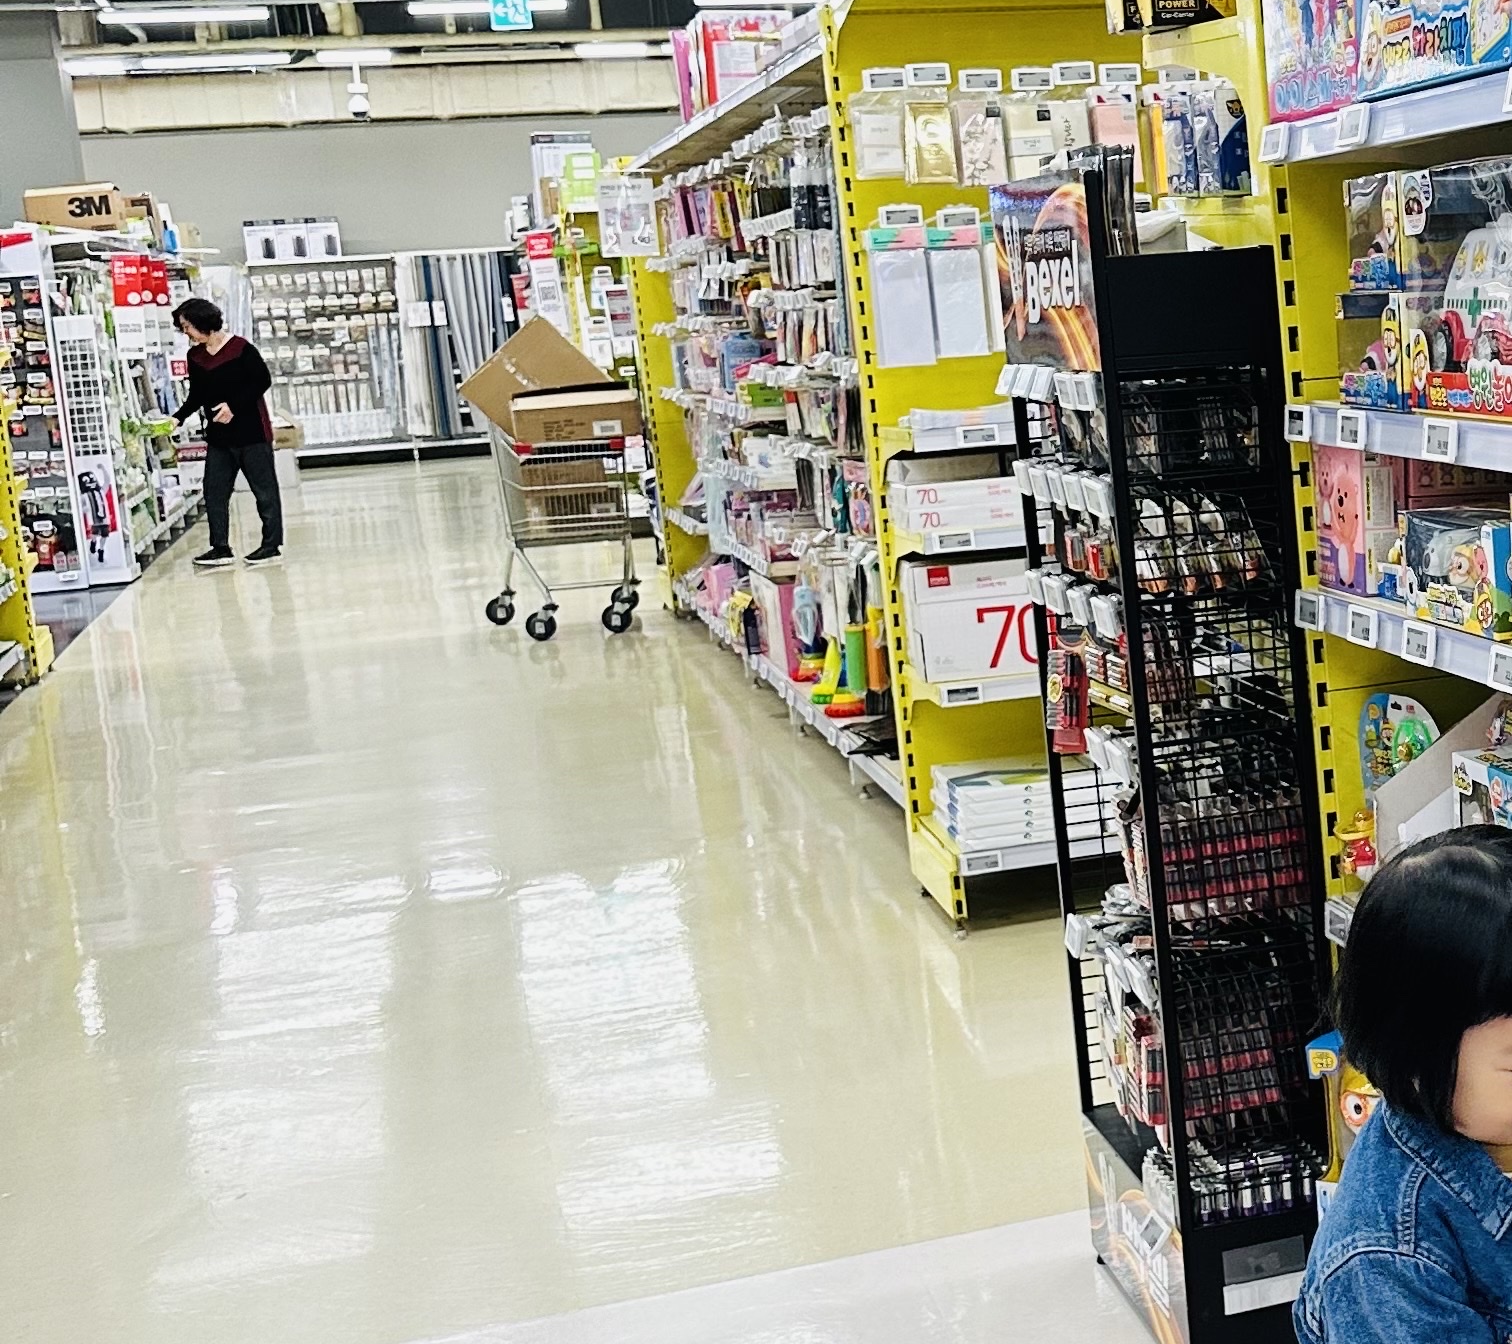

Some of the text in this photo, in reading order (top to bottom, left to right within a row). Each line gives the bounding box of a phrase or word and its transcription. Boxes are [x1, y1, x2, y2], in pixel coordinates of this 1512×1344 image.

[1158, 0, 1196, 9] POWER
[67, 195, 112, 218] 3M
[1025, 240, 1080, 325] Bexel
[917, 487, 938, 505] 70
[920, 512, 942, 529] 70
